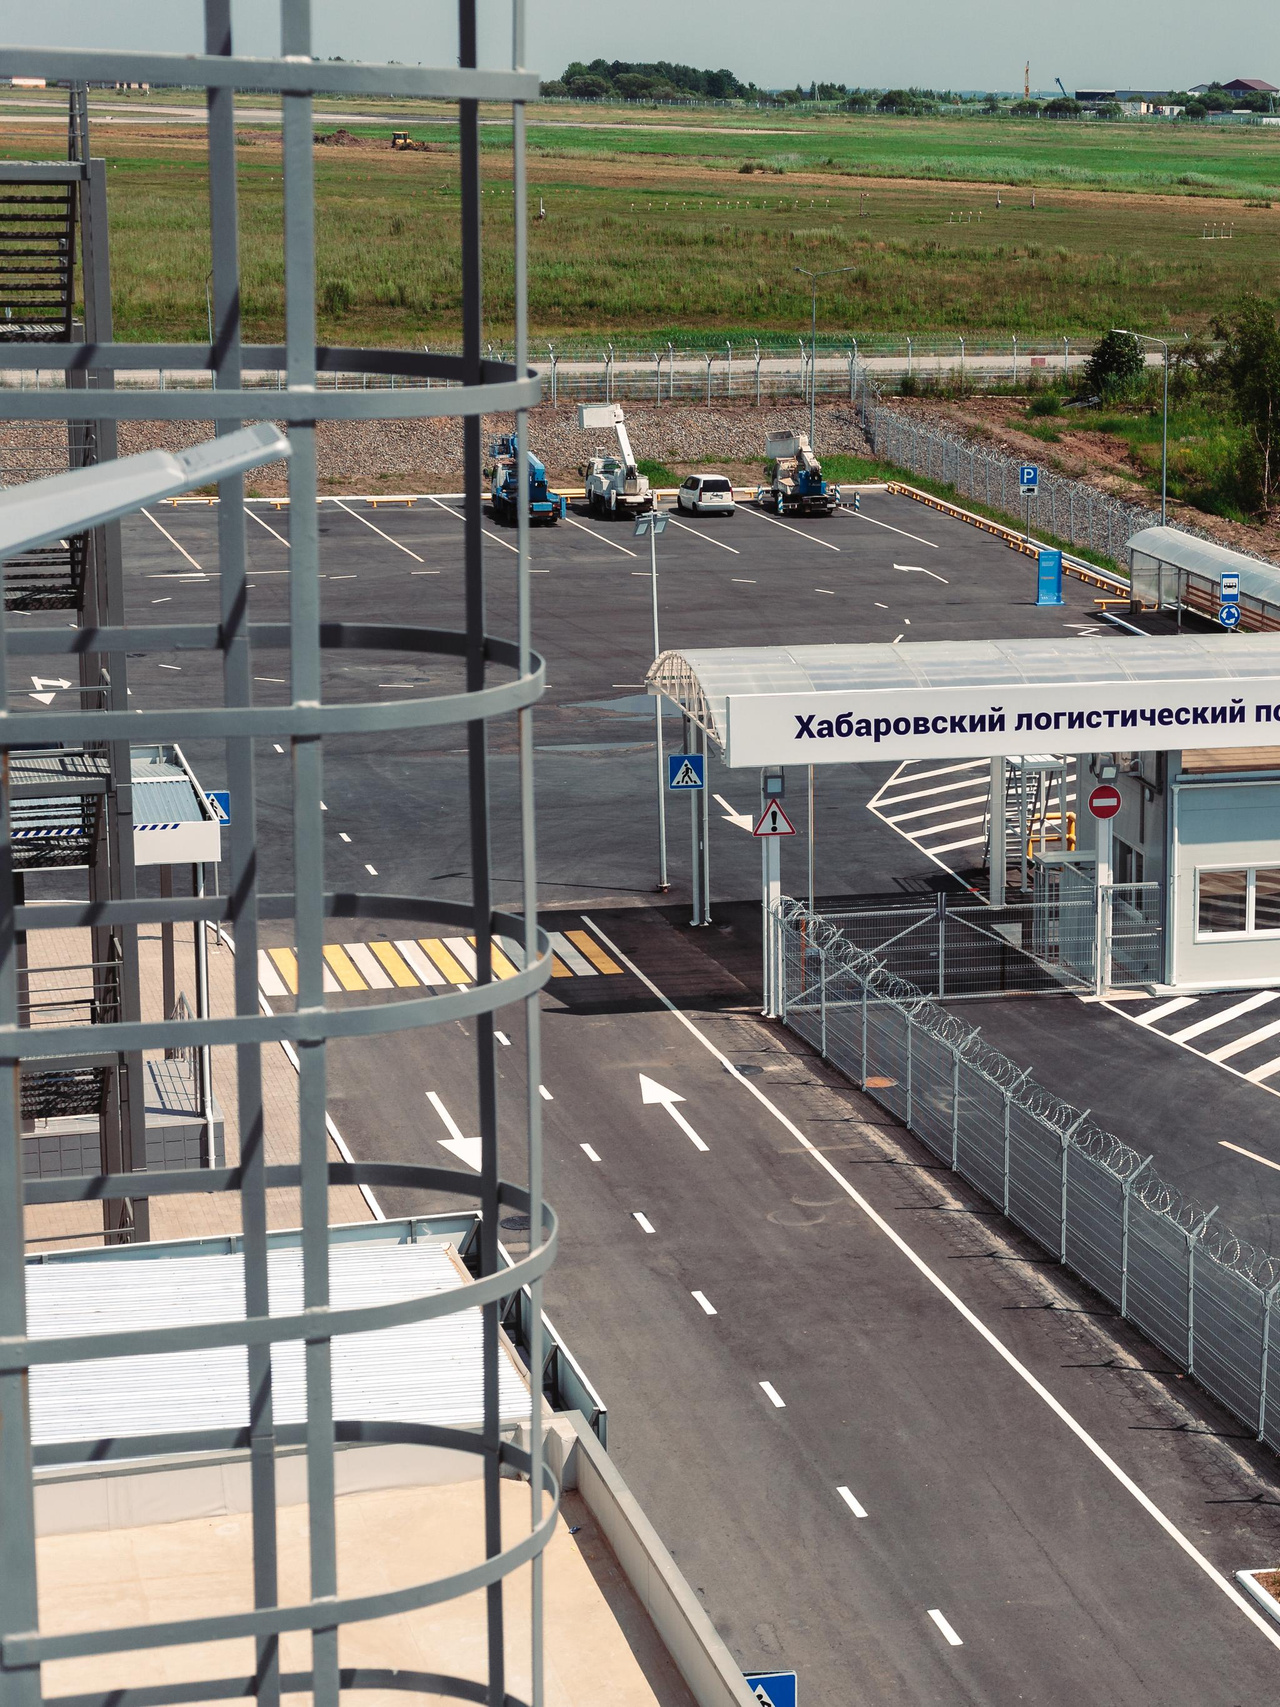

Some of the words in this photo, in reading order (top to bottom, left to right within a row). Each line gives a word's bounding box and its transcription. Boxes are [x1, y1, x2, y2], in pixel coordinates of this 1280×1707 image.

[1024, 469, 1034, 483] P
[794, 706, 1005, 743] Хабаровский
[1014, 698, 1246, 732] логистический
